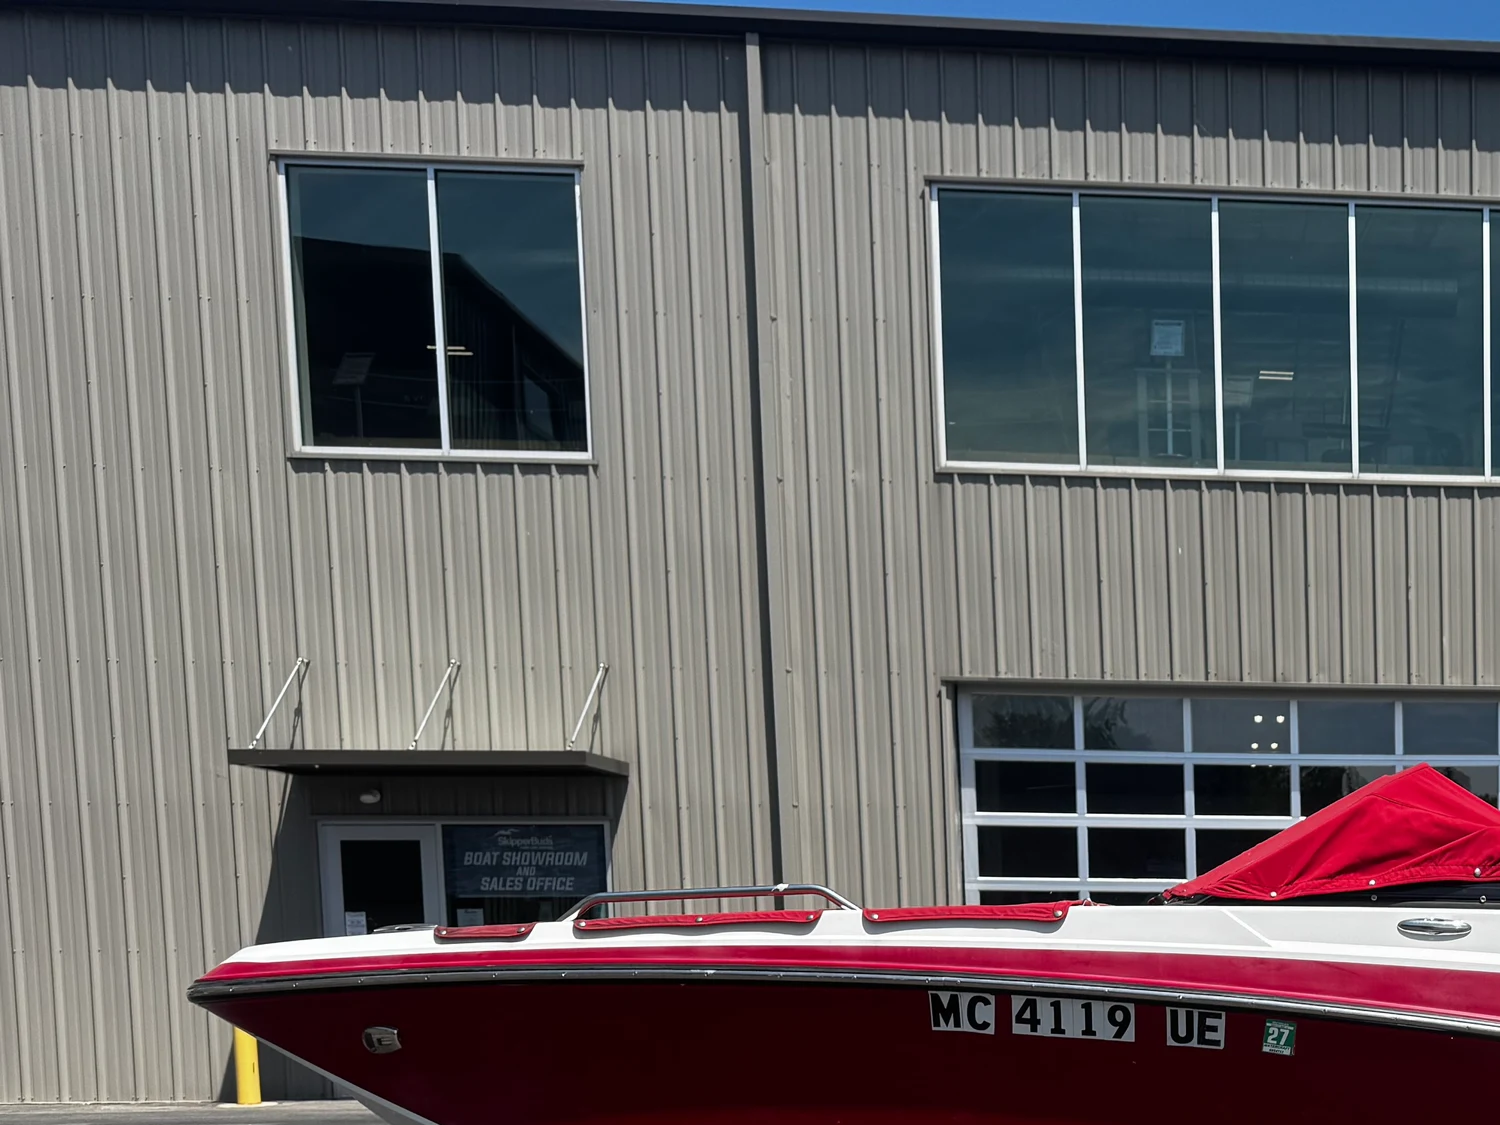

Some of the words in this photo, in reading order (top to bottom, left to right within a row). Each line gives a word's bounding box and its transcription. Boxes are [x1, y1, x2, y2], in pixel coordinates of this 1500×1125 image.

[463, 852, 500, 866] BOAT
[502, 852, 588, 866] SHOWROOM
[516, 866, 536, 876] AND
[480, 877, 524, 891] SALES
[526, 877, 575, 891] OFFICE
[931, 993, 992, 1031] MC
[1015, 997, 1132, 1039] 4119
[1169, 1009, 1223, 1047] UE
[1267, 1027, 1290, 1046] 27
